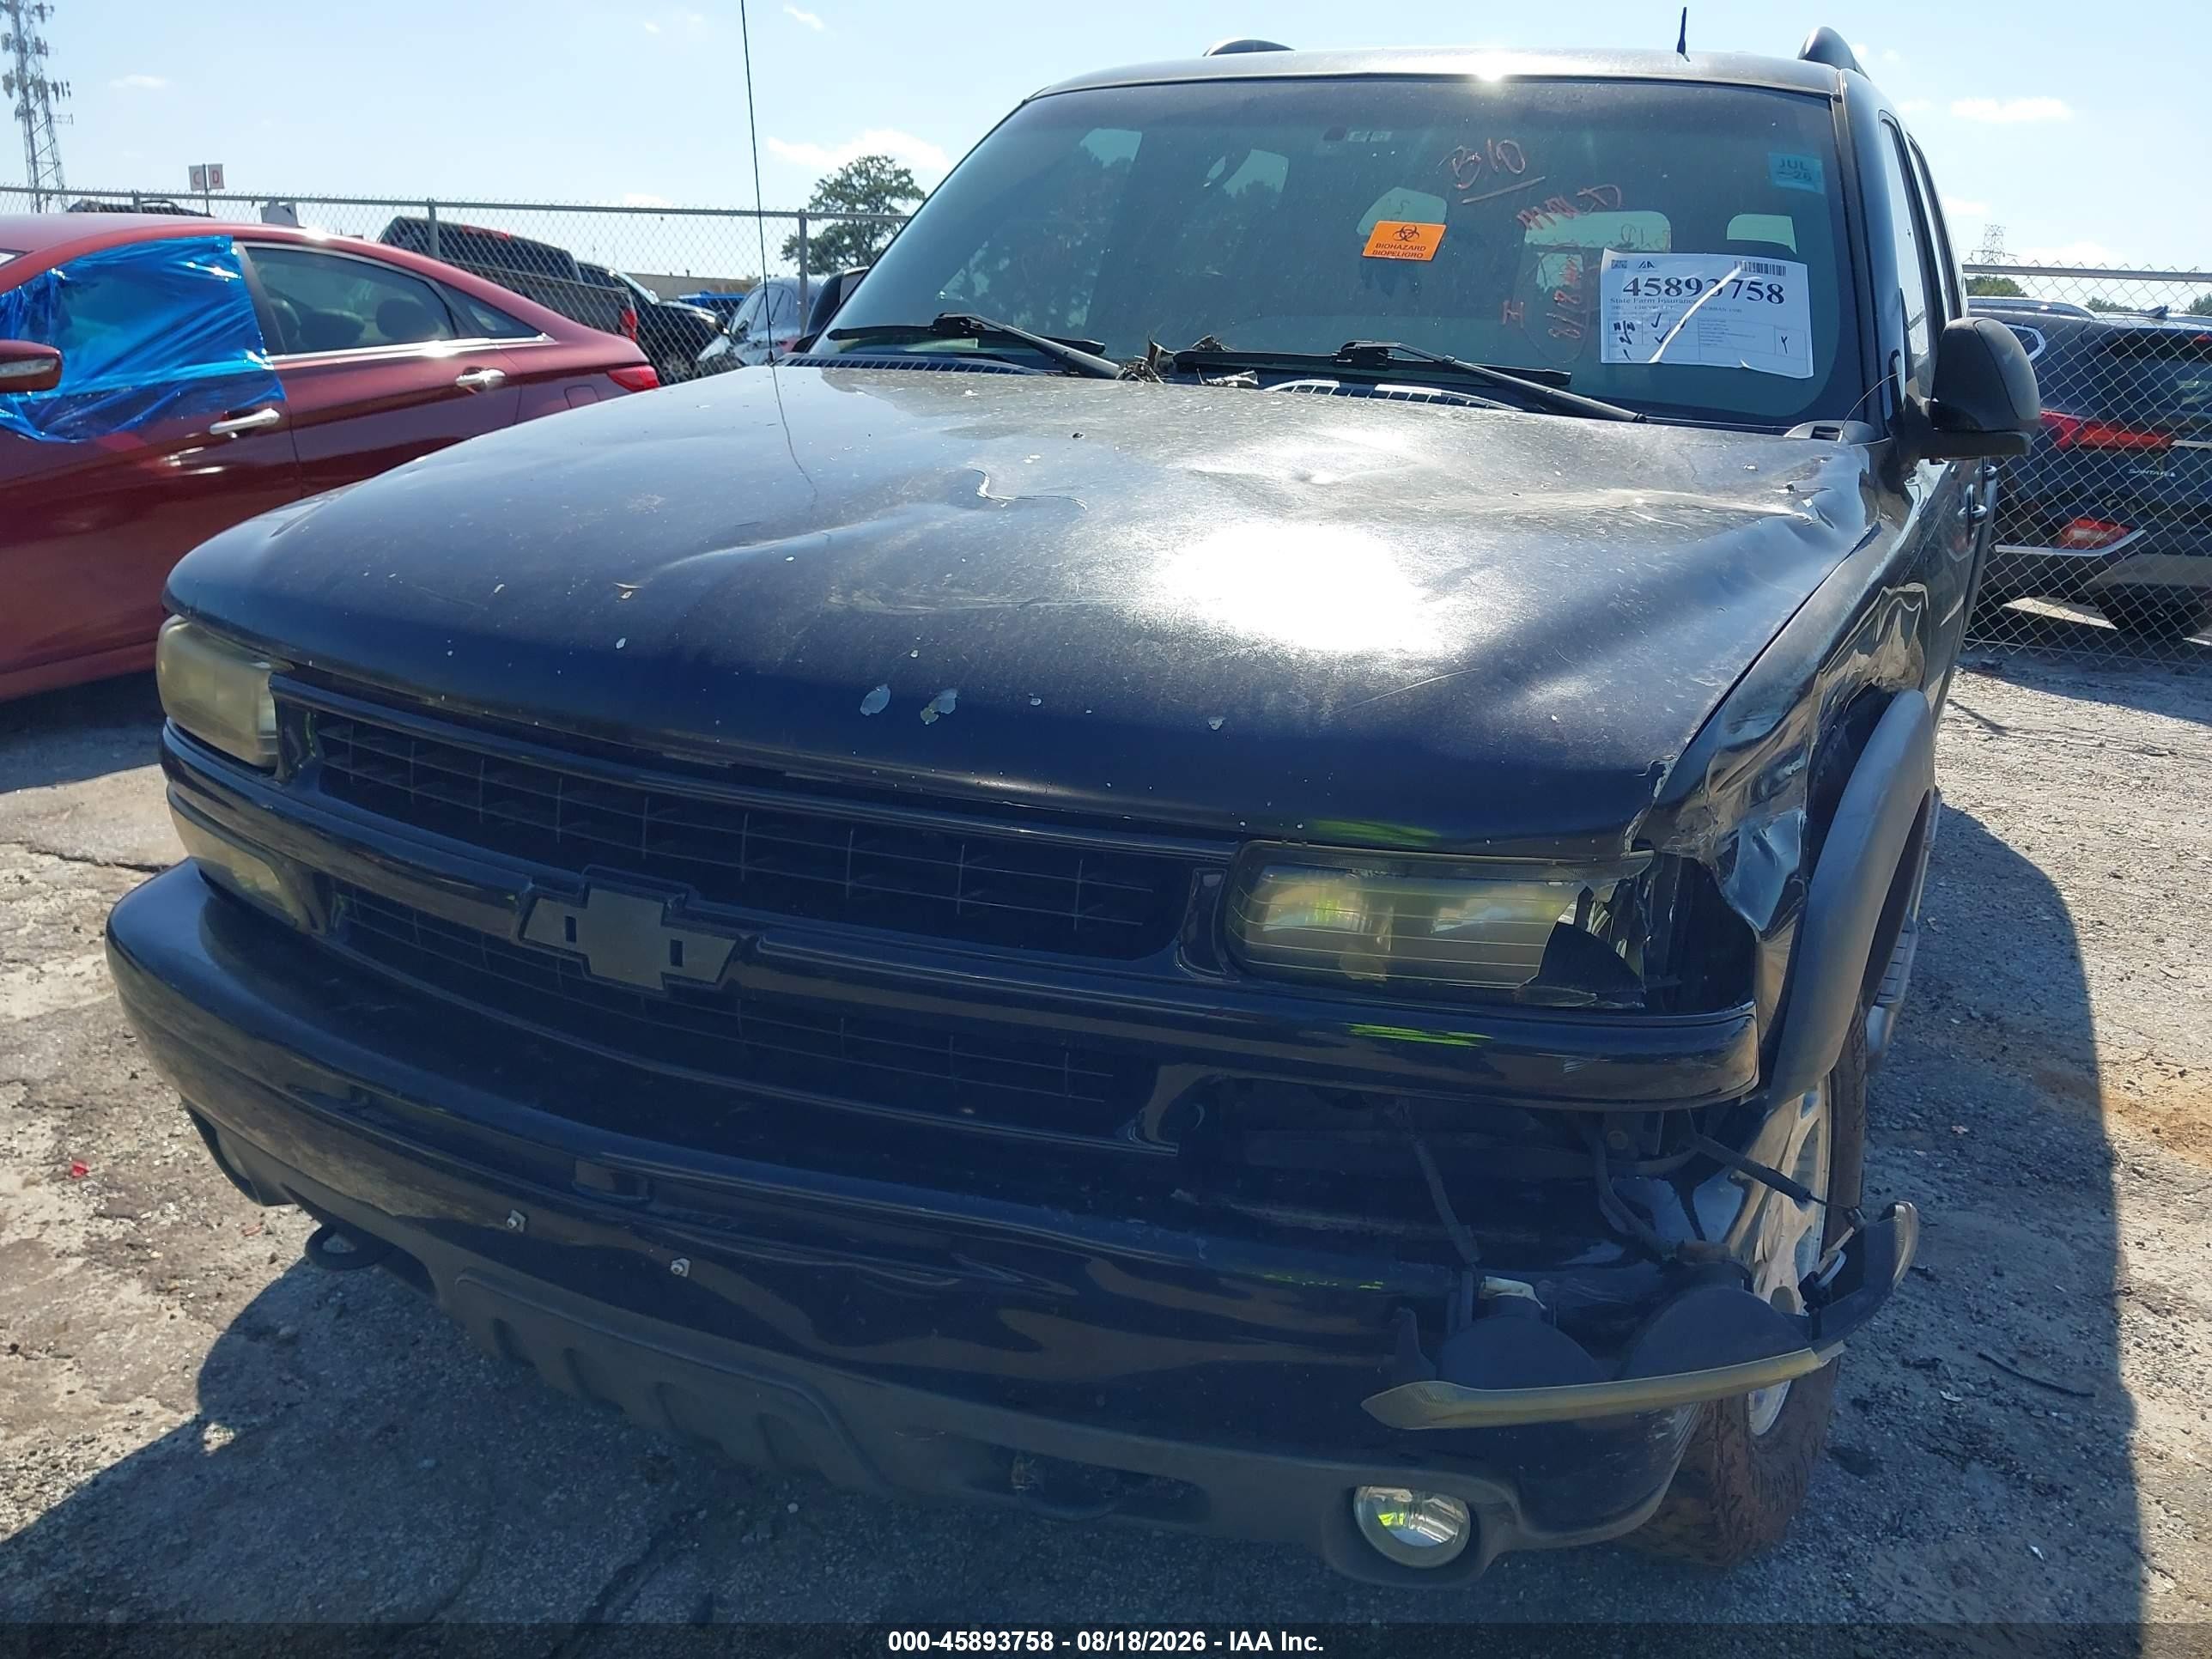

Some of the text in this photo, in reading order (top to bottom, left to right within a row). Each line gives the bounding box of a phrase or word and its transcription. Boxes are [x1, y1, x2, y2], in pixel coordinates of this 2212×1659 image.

[1779, 158, 1808, 171] JUL
[192, 171, 201, 185] C
[212, 169, 220, 184] D
[1372, 250, 1424, 258] BIOPELIGRO
[1375, 243, 1426, 252] BIOHAZARD
